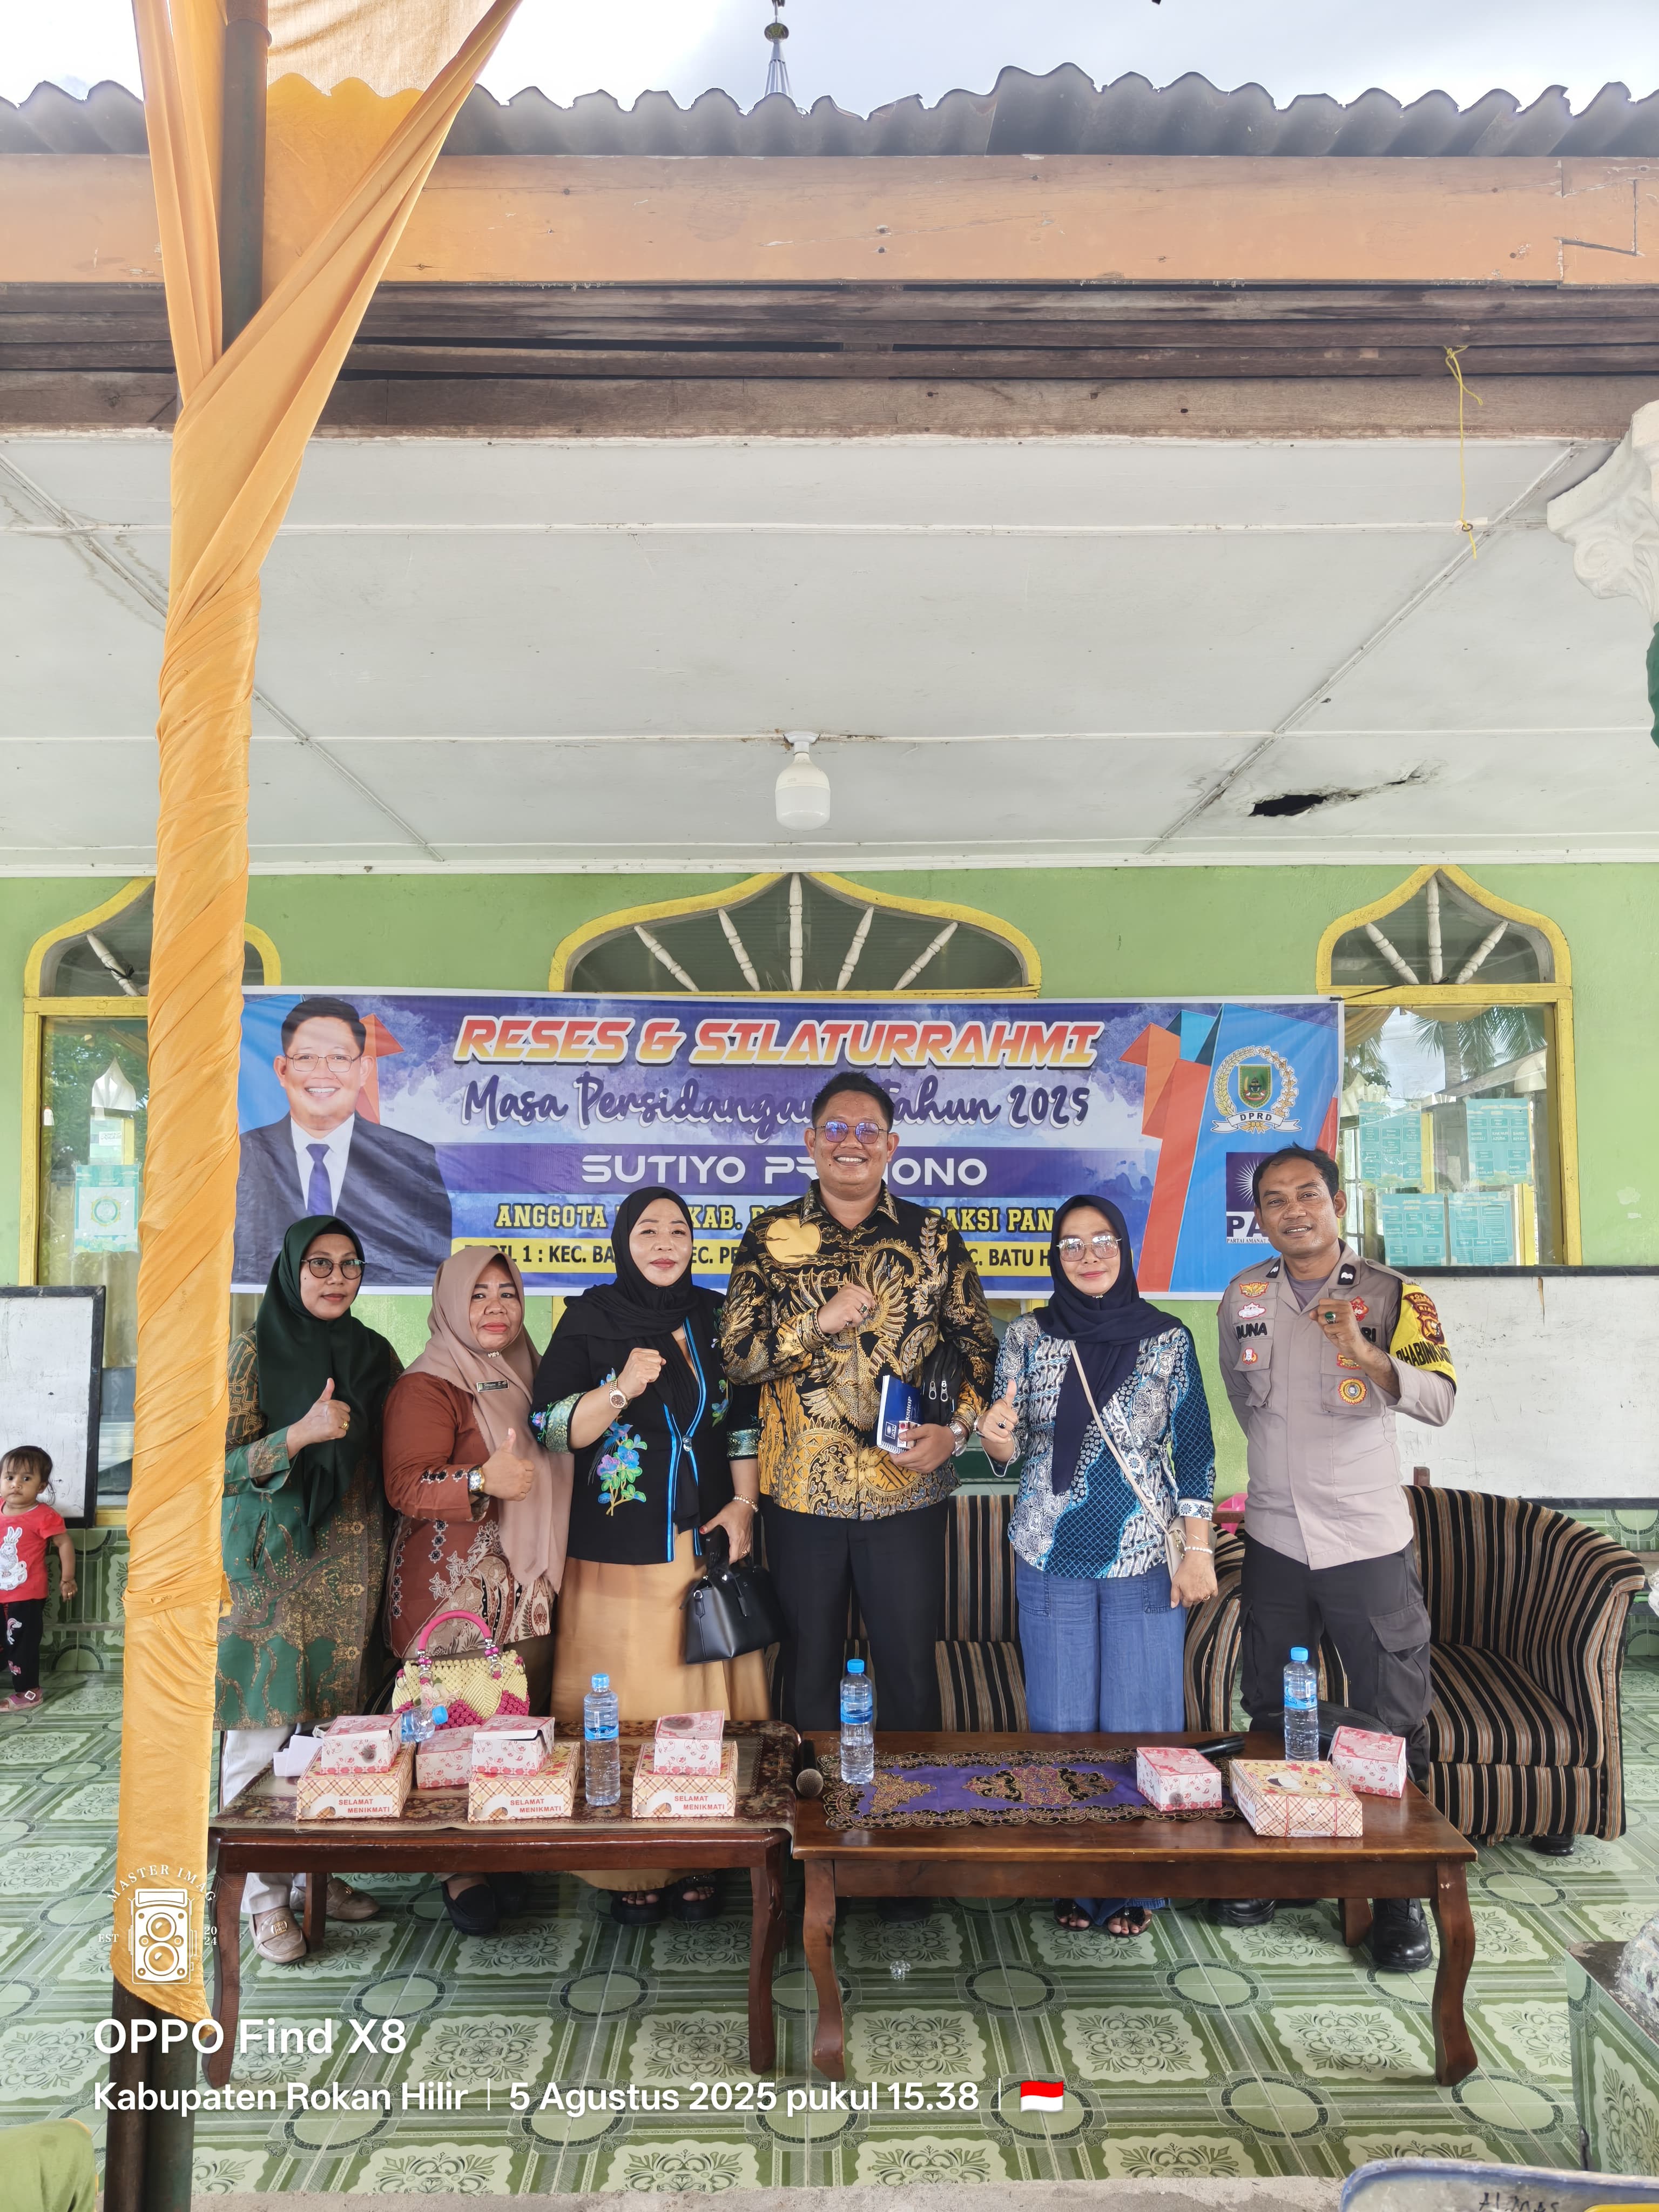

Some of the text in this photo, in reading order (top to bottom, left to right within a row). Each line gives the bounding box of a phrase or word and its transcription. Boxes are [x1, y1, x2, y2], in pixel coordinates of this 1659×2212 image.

[454, 1016, 1104, 1067] RESES & SILATURRAHMI
[462, 1075, 569, 1129] Masa
[1007, 1084, 1090, 1128] 2025
[1239, 1112, 1272, 1121] DPRD
[582, 1155, 746, 1184] SUTIYO
[495, 1203, 608, 1229] ANGGOTA
[1007, 1207, 1056, 1232] PAN
[1226, 1216, 1269, 1237] PA
[523, 1245, 532, 1263] 1
[549, 1245, 586, 1263] KEC.
[989, 1249, 1033, 1266] BATU
